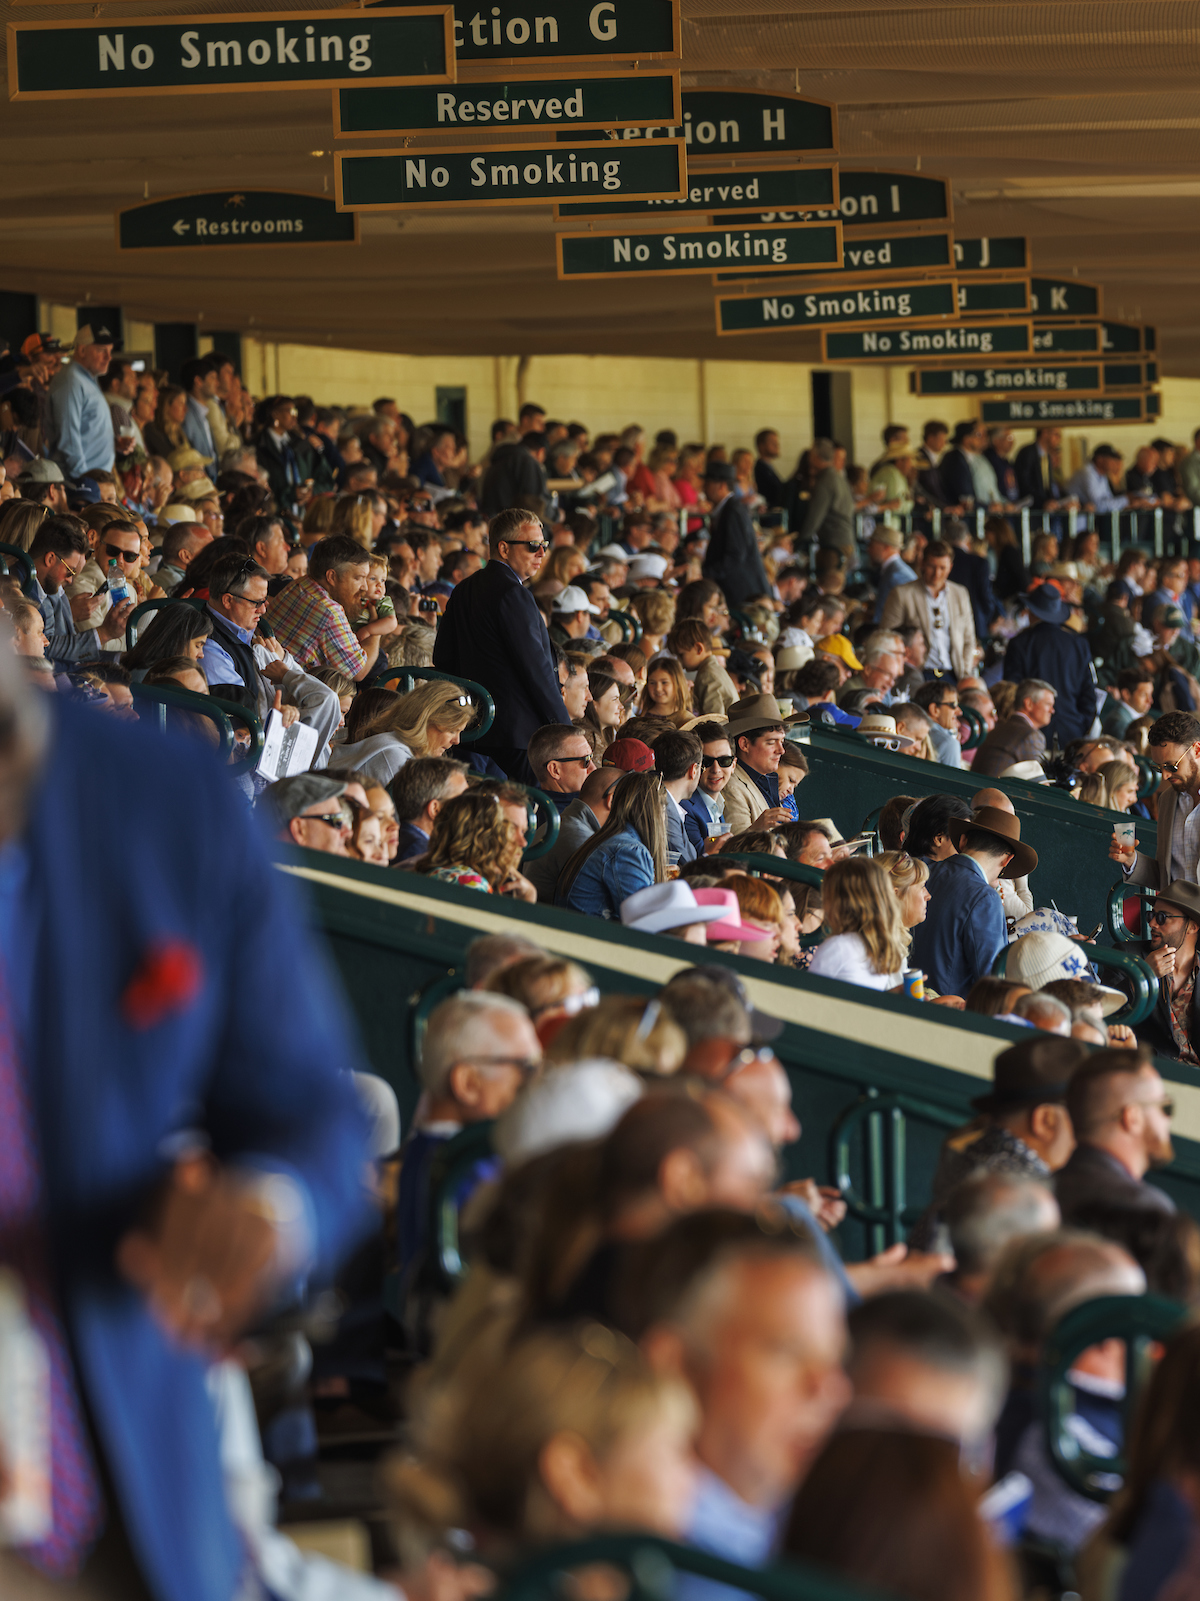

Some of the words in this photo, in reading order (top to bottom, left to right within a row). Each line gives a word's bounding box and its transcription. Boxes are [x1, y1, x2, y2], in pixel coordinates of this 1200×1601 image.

[589, 3, 617, 41] G
[98, 34, 154, 71] No
[180, 25, 372, 72] Smoking
[437, 88, 584, 122] Reserved
[762, 109, 785, 141] H
[405, 158, 450, 189] No
[470, 153, 622, 190] Smoking
[648, 178, 759, 205] erved
[196, 217, 304, 236] Restrooms
[613, 237, 650, 262] No
[663, 232, 788, 263] Smoking
[979, 237, 990, 267] J
[762, 298, 795, 320] No
[805, 290, 912, 316] Smoking
[1051, 286, 1068, 310] K
[862, 332, 892, 352] No
[899, 328, 993, 352] Smoking
[951, 370, 978, 388] No
[984, 368, 1068, 390] Smoking
[1009, 402, 1034, 417] No
[1039, 399, 1114, 419] Smoking
